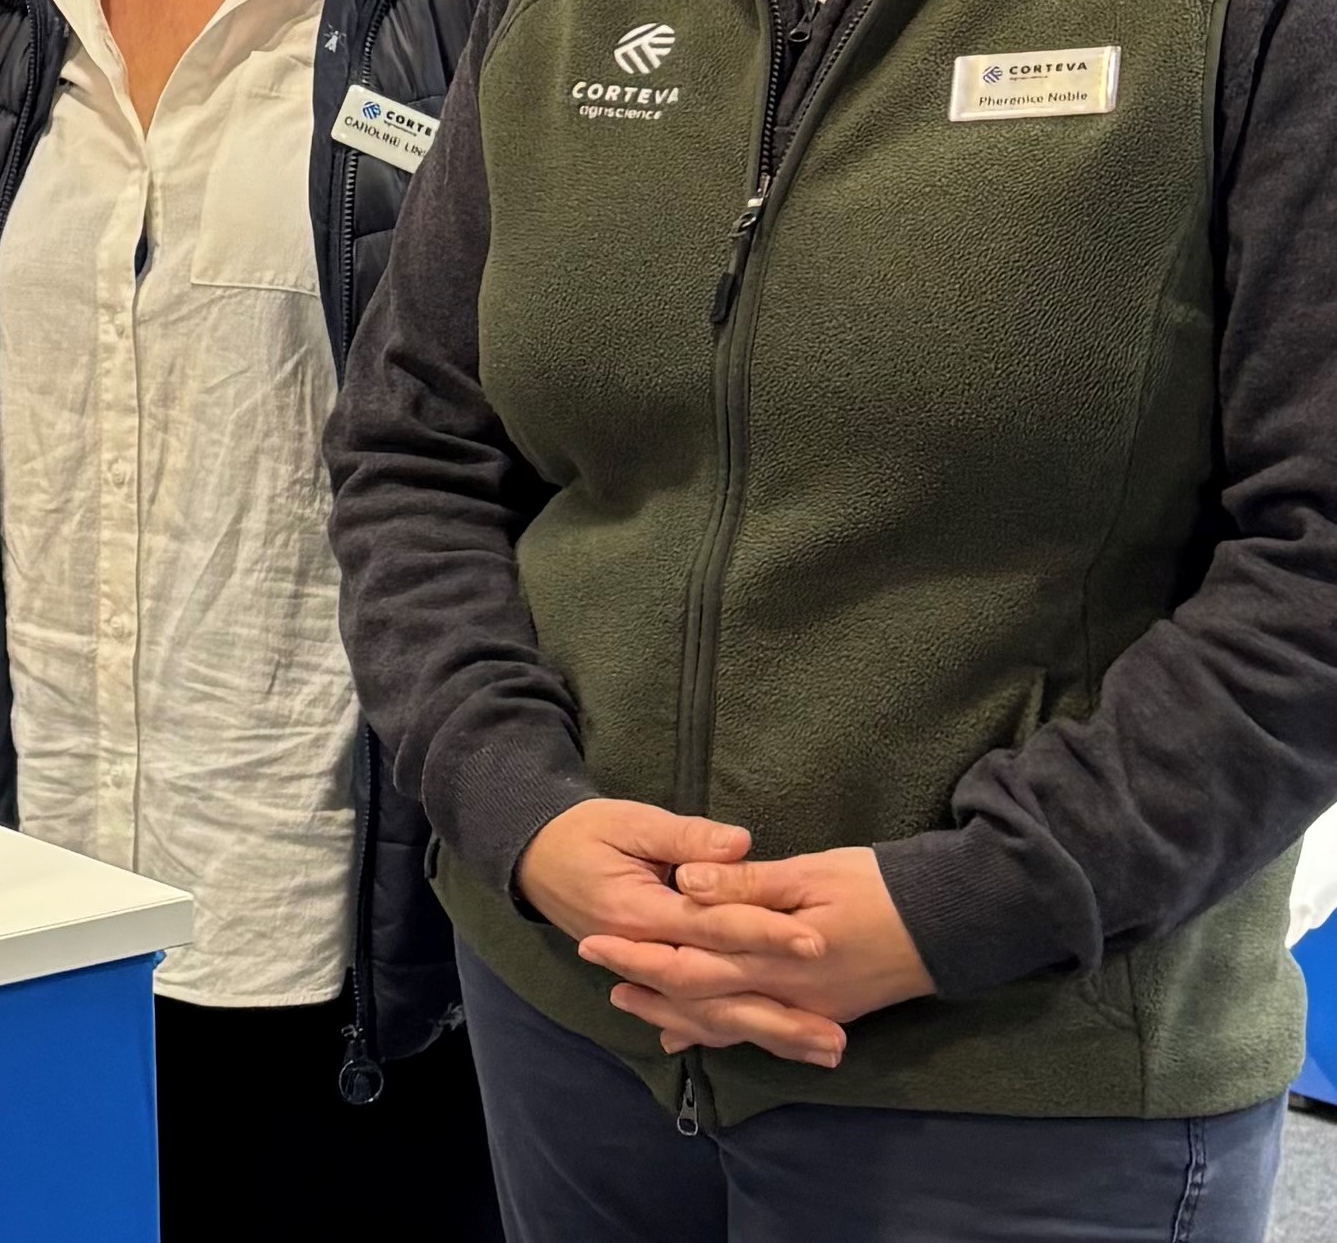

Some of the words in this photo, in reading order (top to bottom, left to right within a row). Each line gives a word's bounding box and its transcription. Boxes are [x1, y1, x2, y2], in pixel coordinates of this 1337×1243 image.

[1009, 61, 1088, 76] CORTEVA
[571, 81, 680, 105] CORTEVA
[579, 105, 664, 121] agriscience
[386, 110, 434, 137] CORTE
